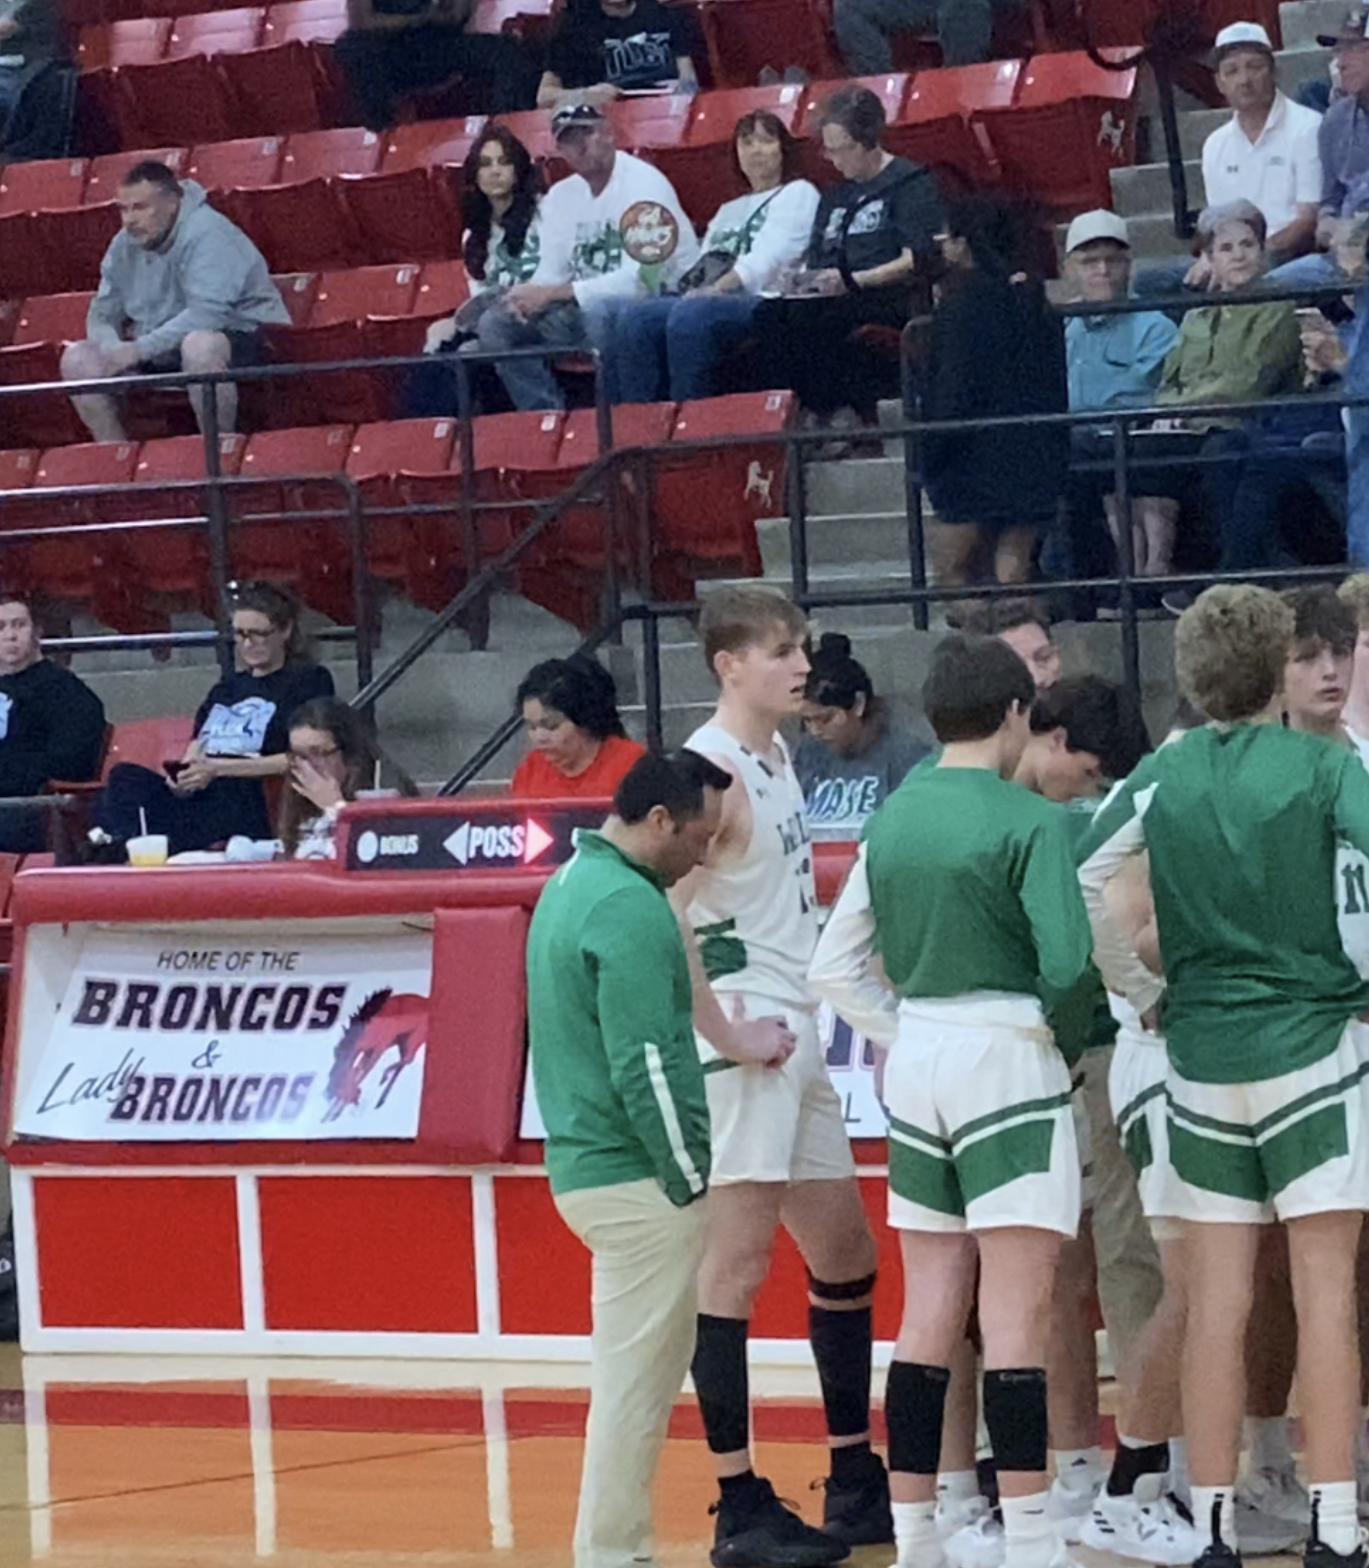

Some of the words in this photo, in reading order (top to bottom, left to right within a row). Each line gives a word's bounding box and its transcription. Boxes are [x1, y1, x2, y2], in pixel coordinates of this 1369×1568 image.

[468, 825, 526, 859] POSS
[156, 951, 221, 971] HOME
[225, 951, 256, 971] OF
[260, 951, 301, 971] THE
[72, 977, 349, 1032] BRONCOS
[191, 1040, 221, 1068] &
[36, 1047, 146, 1114] Lady
[108, 1072, 317, 1124] BRONCOS
